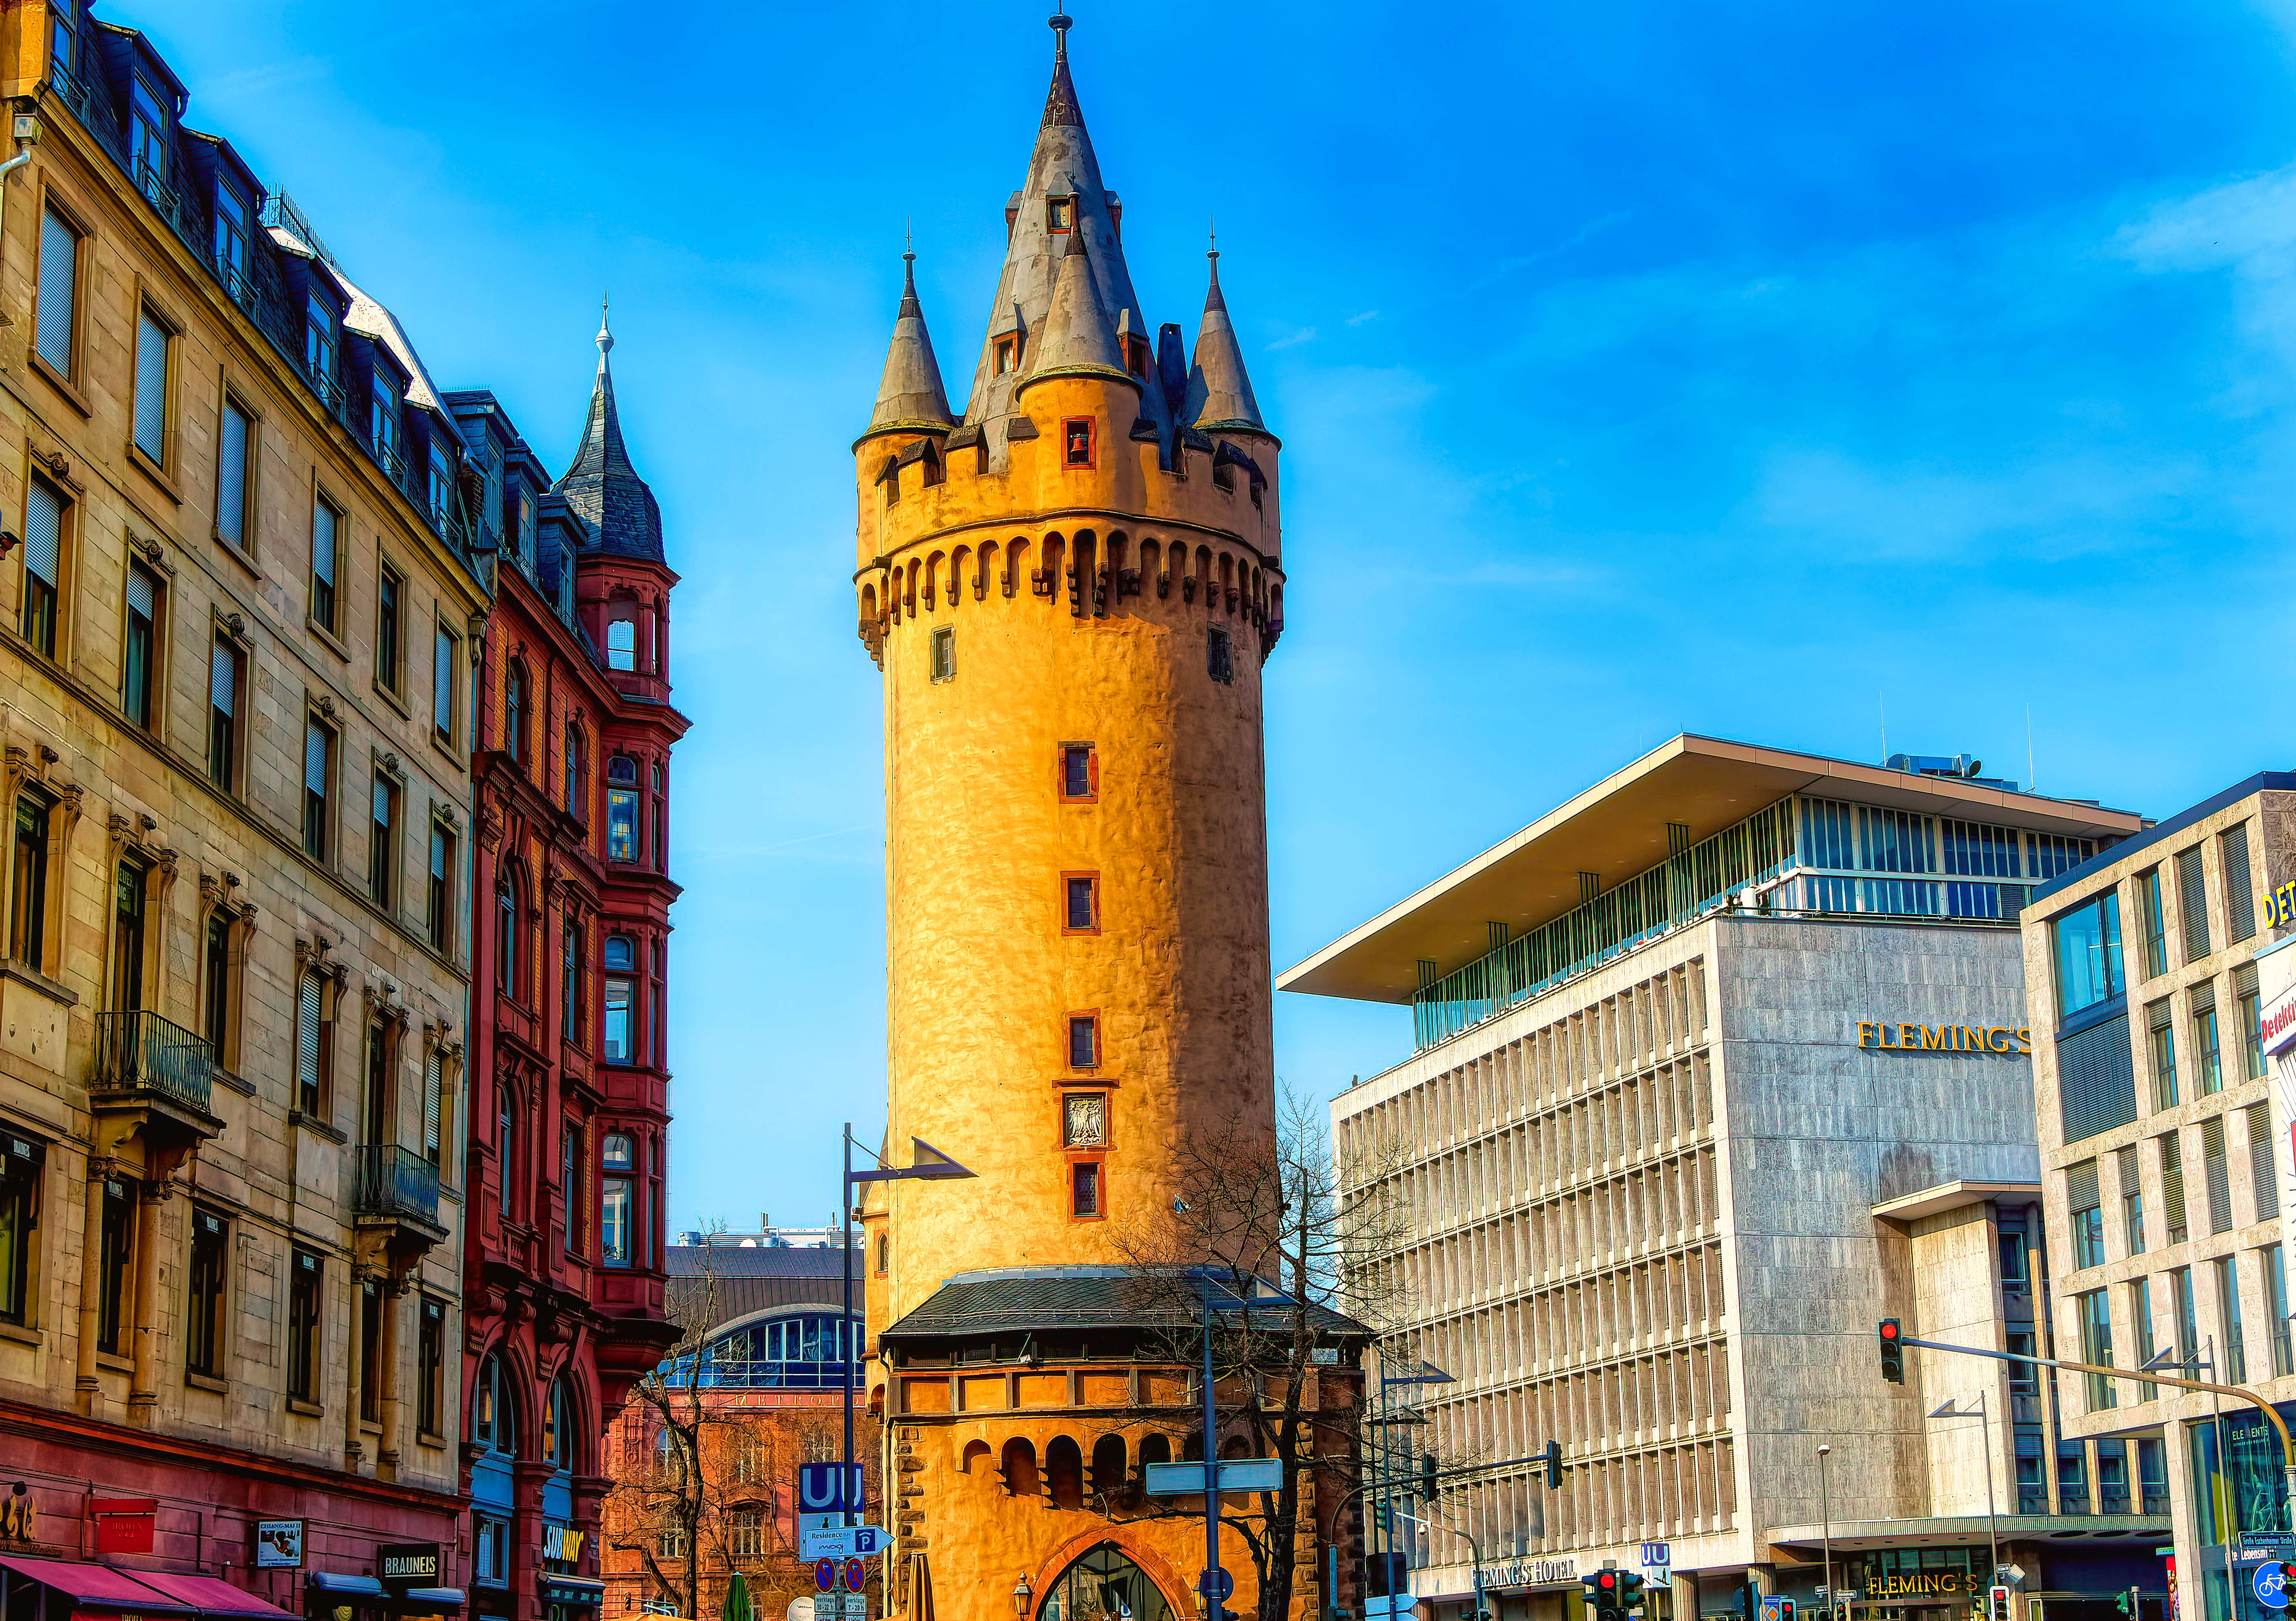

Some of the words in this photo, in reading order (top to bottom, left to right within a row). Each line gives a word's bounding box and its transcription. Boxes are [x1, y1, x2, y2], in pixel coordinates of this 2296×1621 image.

[2262, 880, 2296, 928] DET
[1855, 1022, 2030, 1052] FLEMING'S
[803, 1468, 835, 1507] U
[544, 1526, 584, 1562] SUBWAY
[2243, 1537, 2254, 1545] Große
[2255, 1536, 2279, 1544] Eschenheimer
[385, 1557, 435, 1574] BRAUNEIS
[1642, 1546, 1650, 1564] U
[1652, 1546, 1668, 1563] U
[1529, 1559, 1576, 1582] HOTEL
[1870, 1573, 1977, 1594] FLEMING'S
